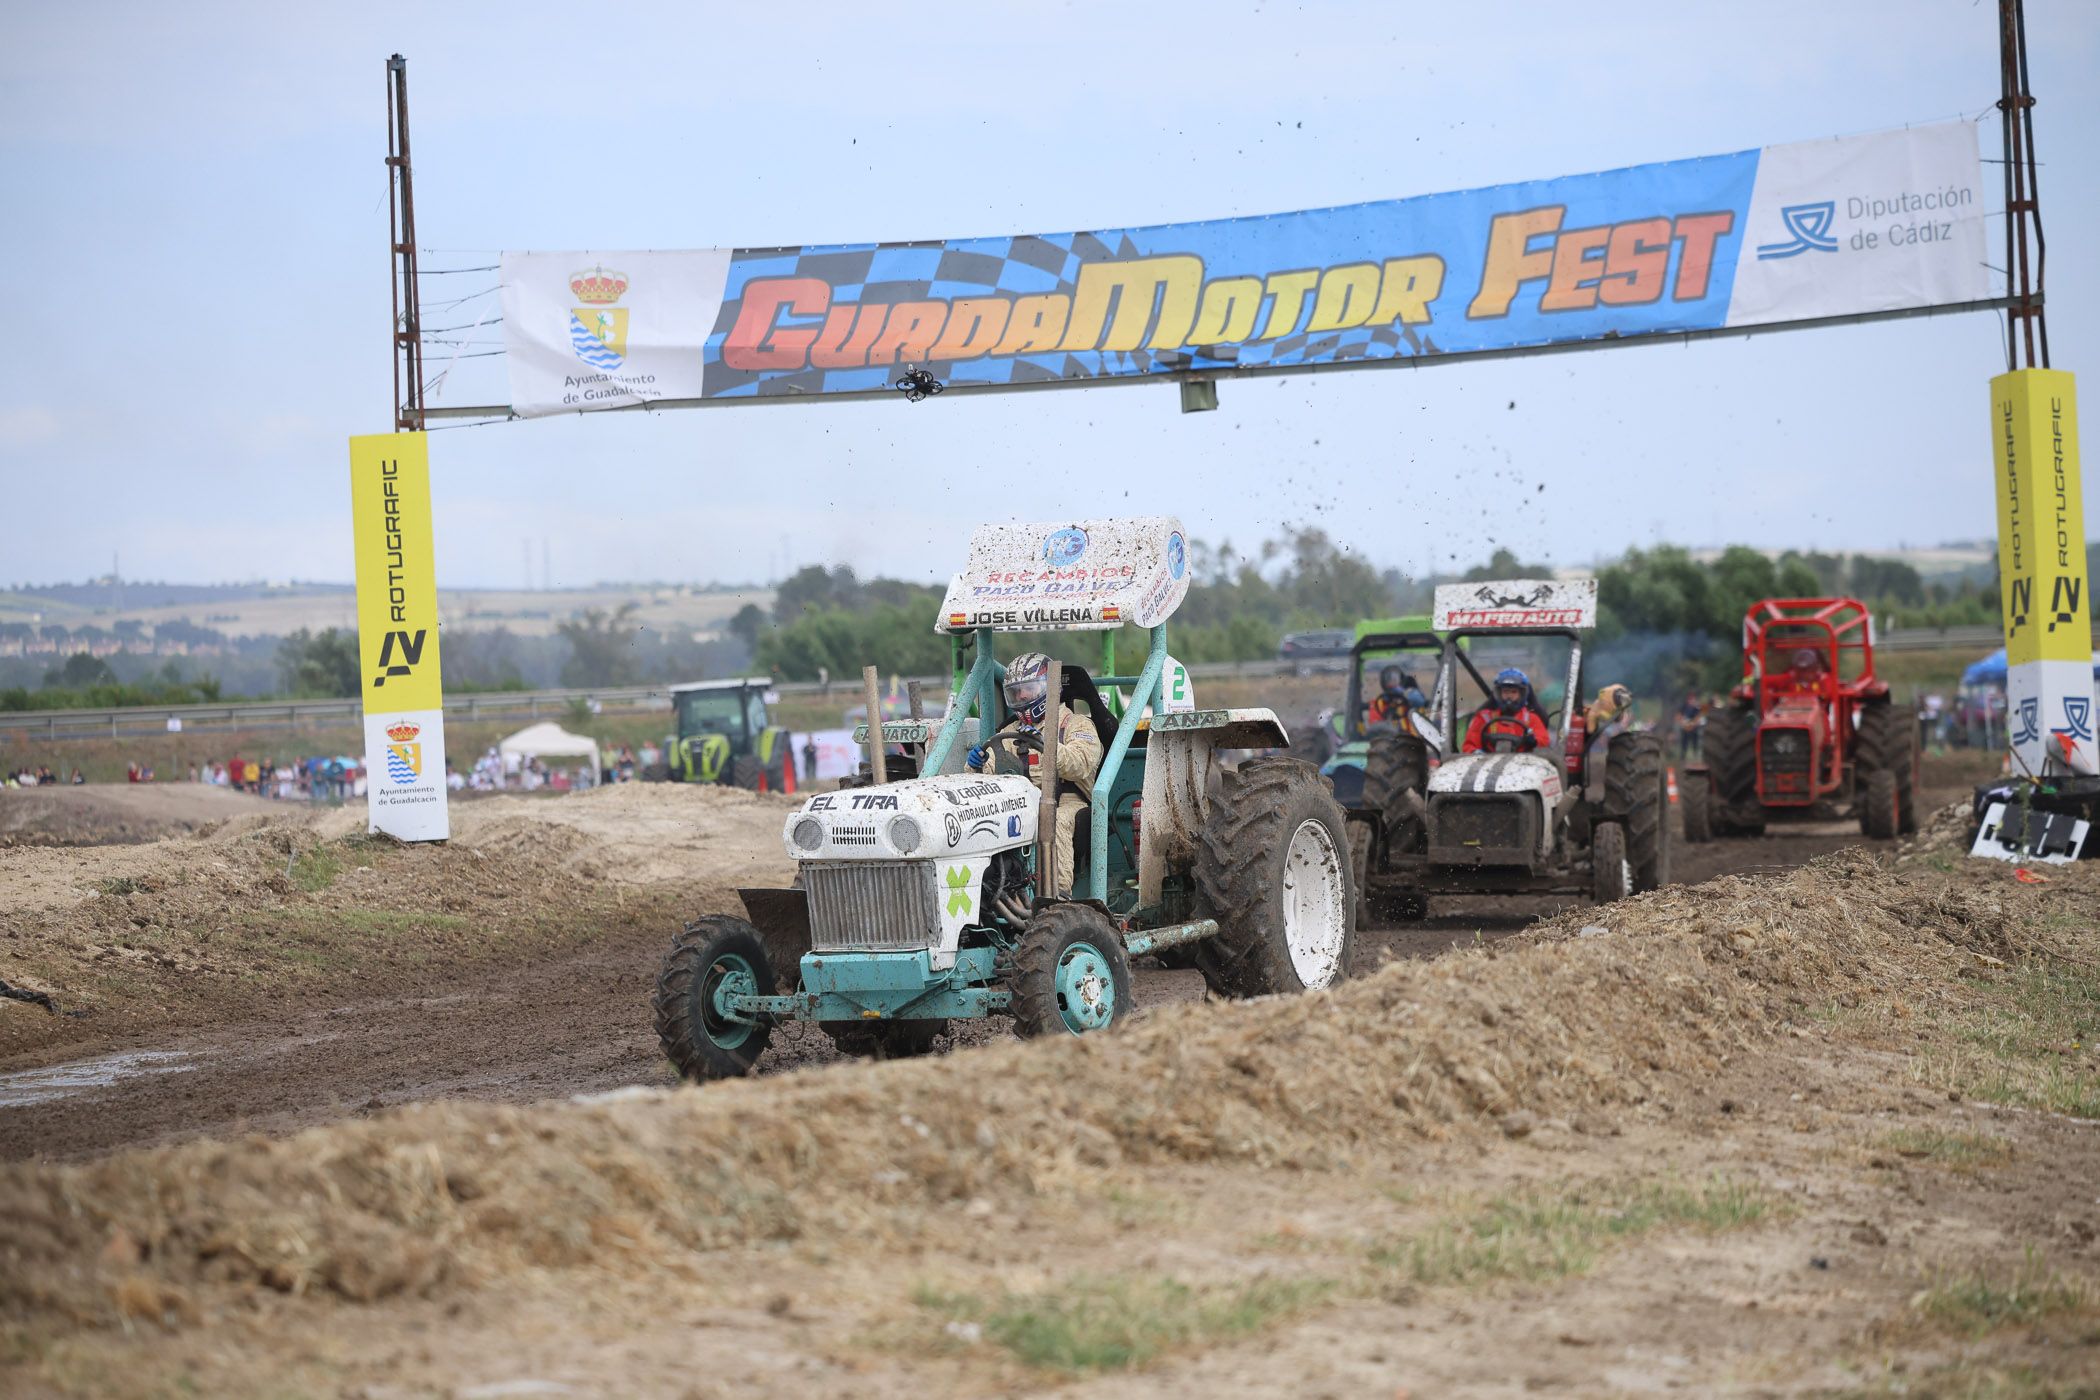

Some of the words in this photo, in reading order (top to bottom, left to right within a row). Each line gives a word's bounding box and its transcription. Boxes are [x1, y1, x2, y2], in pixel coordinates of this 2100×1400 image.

[1846, 186, 1973, 220] Diputación
[1850, 229, 1878, 251] de
[1888, 222, 1952, 247] Cádiz
[1465, 205, 1735, 320] FEST
[563, 393, 580, 405] de
[2003, 399, 2022, 571] ROTUGRAFIC
[2051, 397, 2069, 568] ROTUGRAFIC
[382, 459, 406, 622] ROTUGRAFIC
[987, 564, 1133, 585] RECAMBIOS
[973, 583, 1036, 597] PACO
[1044, 579, 1136, 594] GALVEZ
[967, 610, 1017, 626] JOSE
[1023, 606, 1093, 624] VILLENA
[1172, 666, 1185, 701] 2
[1162, 713, 1218, 728] ANA
[862, 727, 920, 742] AVARO
[378, 798, 388, 806] de
[379, 787, 435, 796] Ayuntamiento
[809, 796, 838, 812] EL
[851, 795, 899, 811] TIRA
[957, 802, 1000, 823] HIDRAULICA
